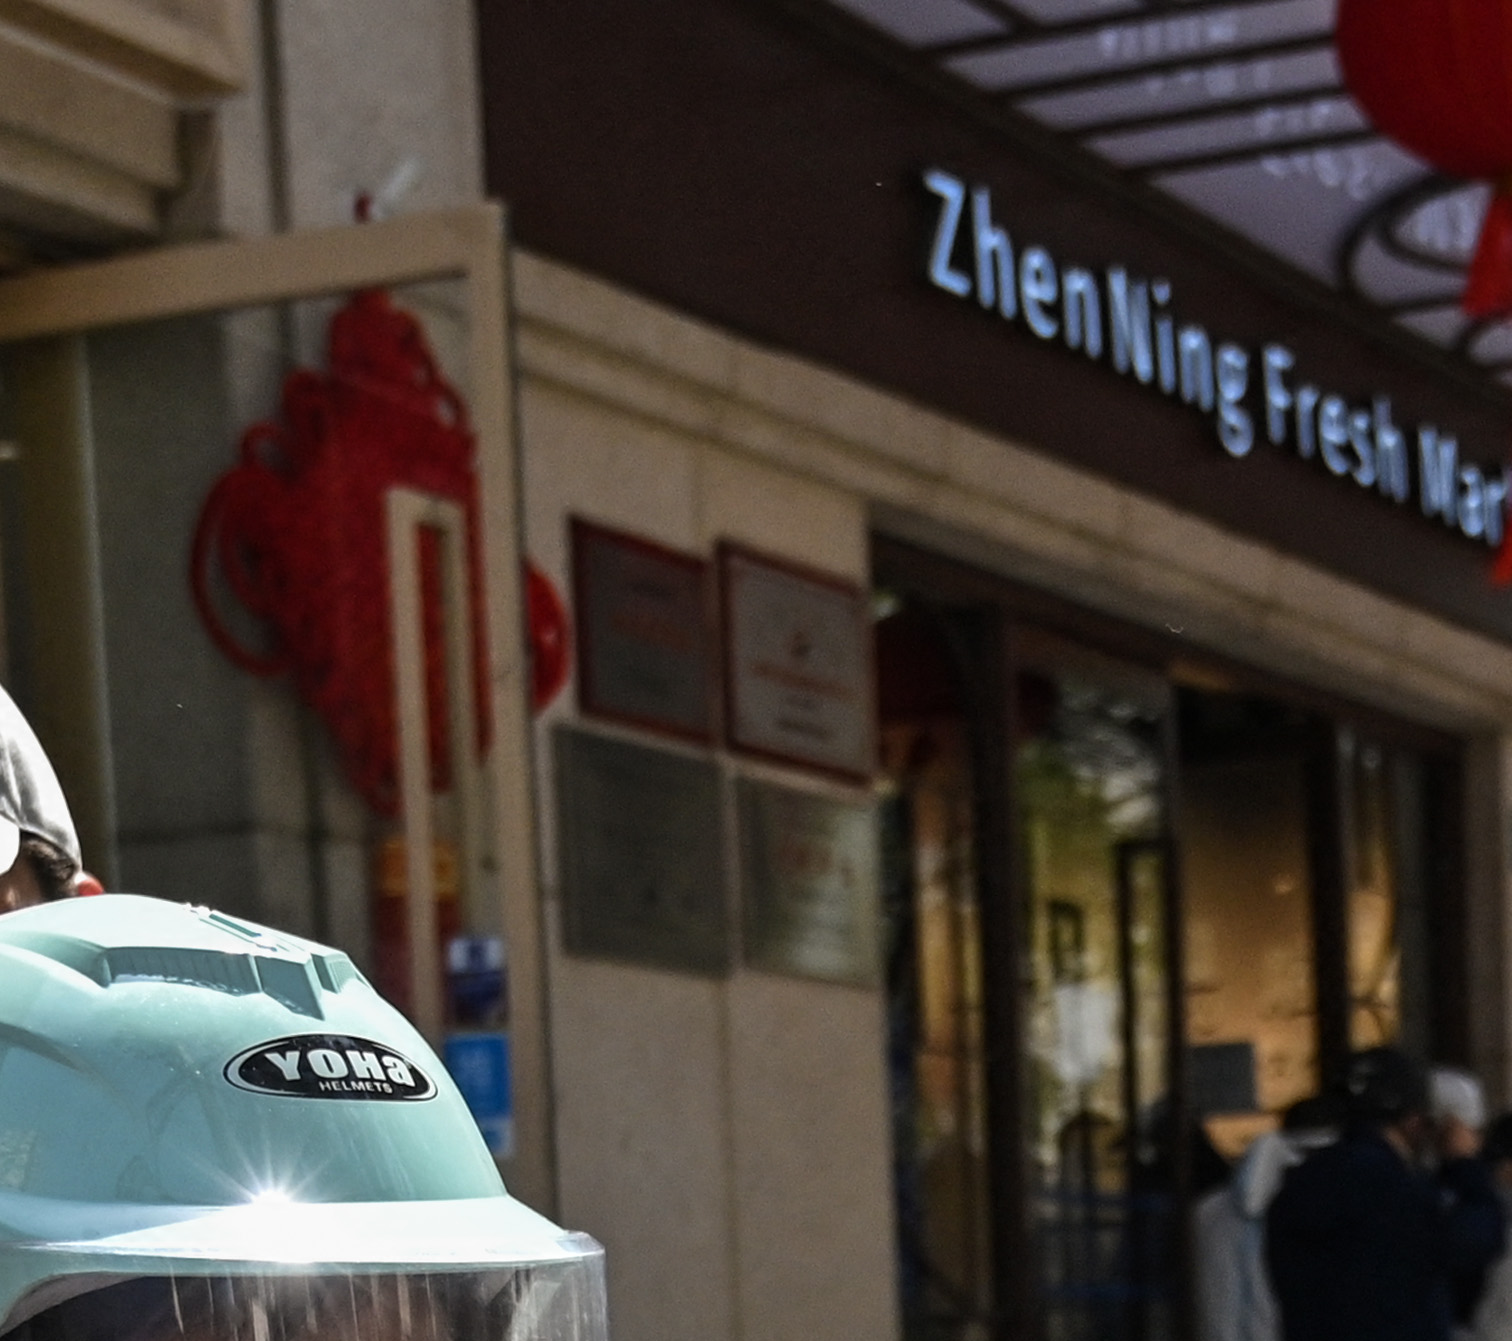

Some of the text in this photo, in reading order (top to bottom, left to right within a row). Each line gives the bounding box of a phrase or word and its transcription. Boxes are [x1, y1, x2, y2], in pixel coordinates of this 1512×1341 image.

[923, 170, 1254, 457] ZhenNing
[1262, 344, 1410, 504] Fresh
[318, 1080, 393, 1094] HELMETS
